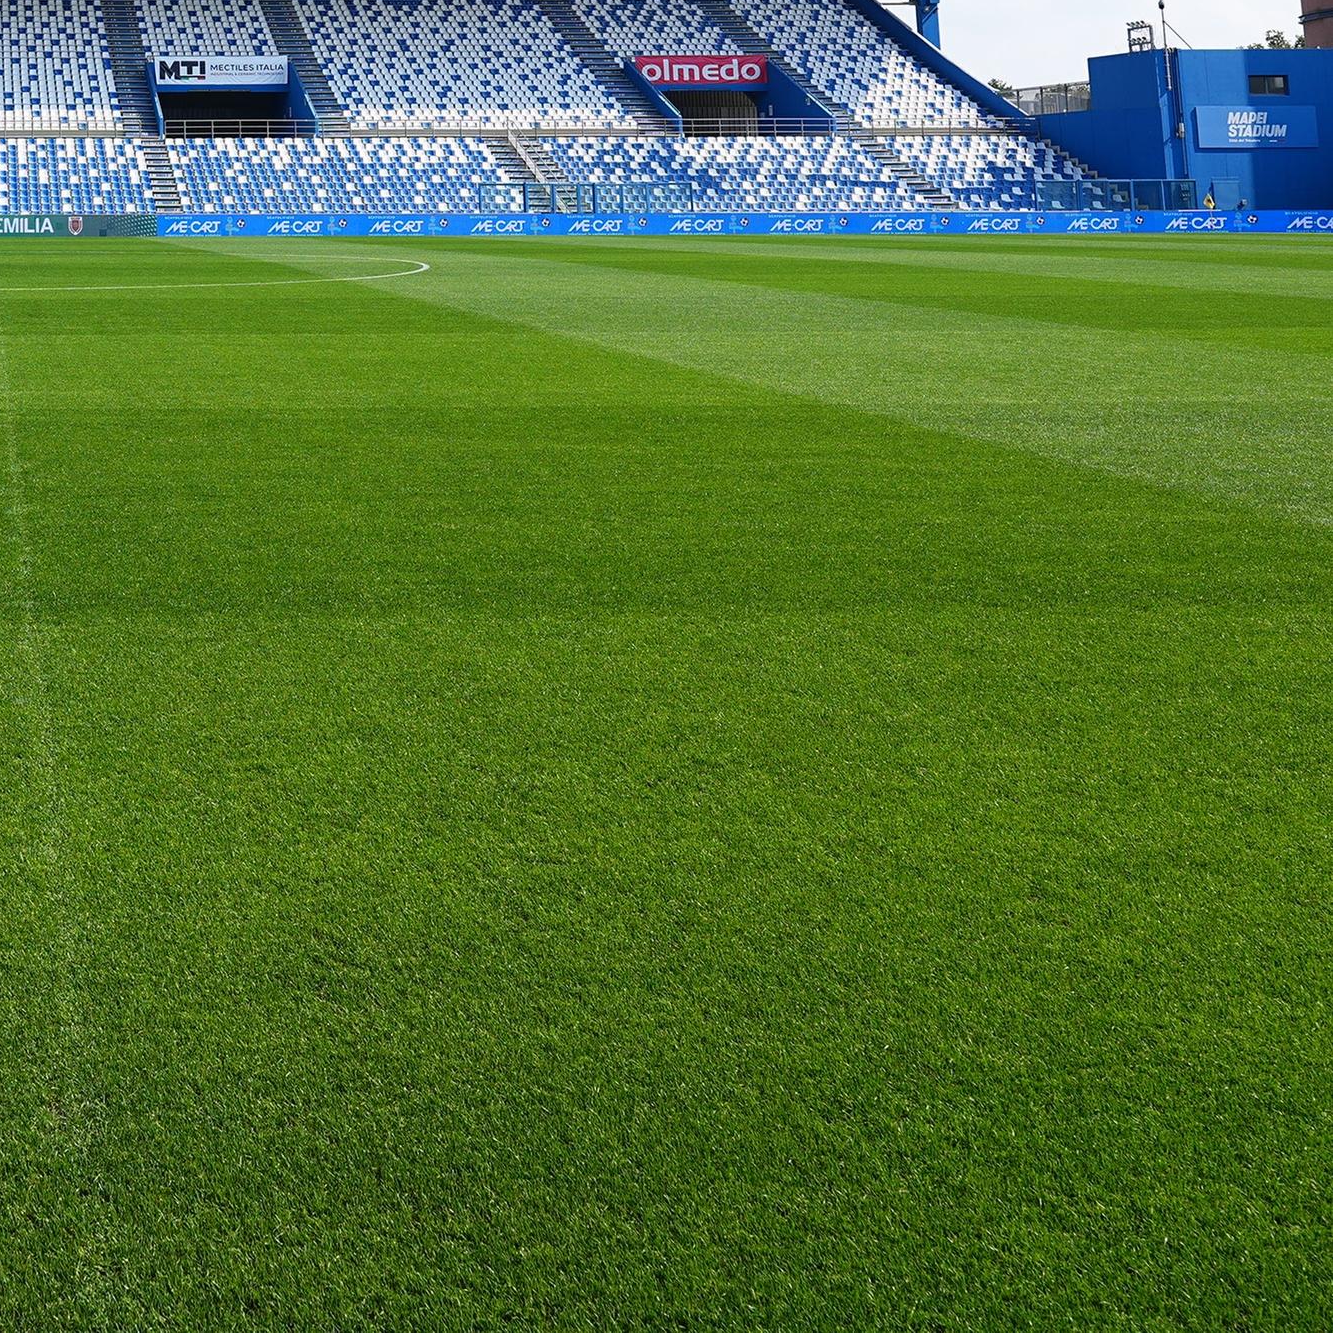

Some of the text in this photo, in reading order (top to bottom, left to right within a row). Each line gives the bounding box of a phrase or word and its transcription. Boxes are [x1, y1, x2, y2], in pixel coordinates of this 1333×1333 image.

[159, 61, 206, 80] MTI
[210, 64, 284, 72] MECTILES ITALIA
[641, 58, 761, 82] olmedo
[1227, 111, 1268, 124] MAPEI
[1228, 124, 1287, 137] STADIUM
